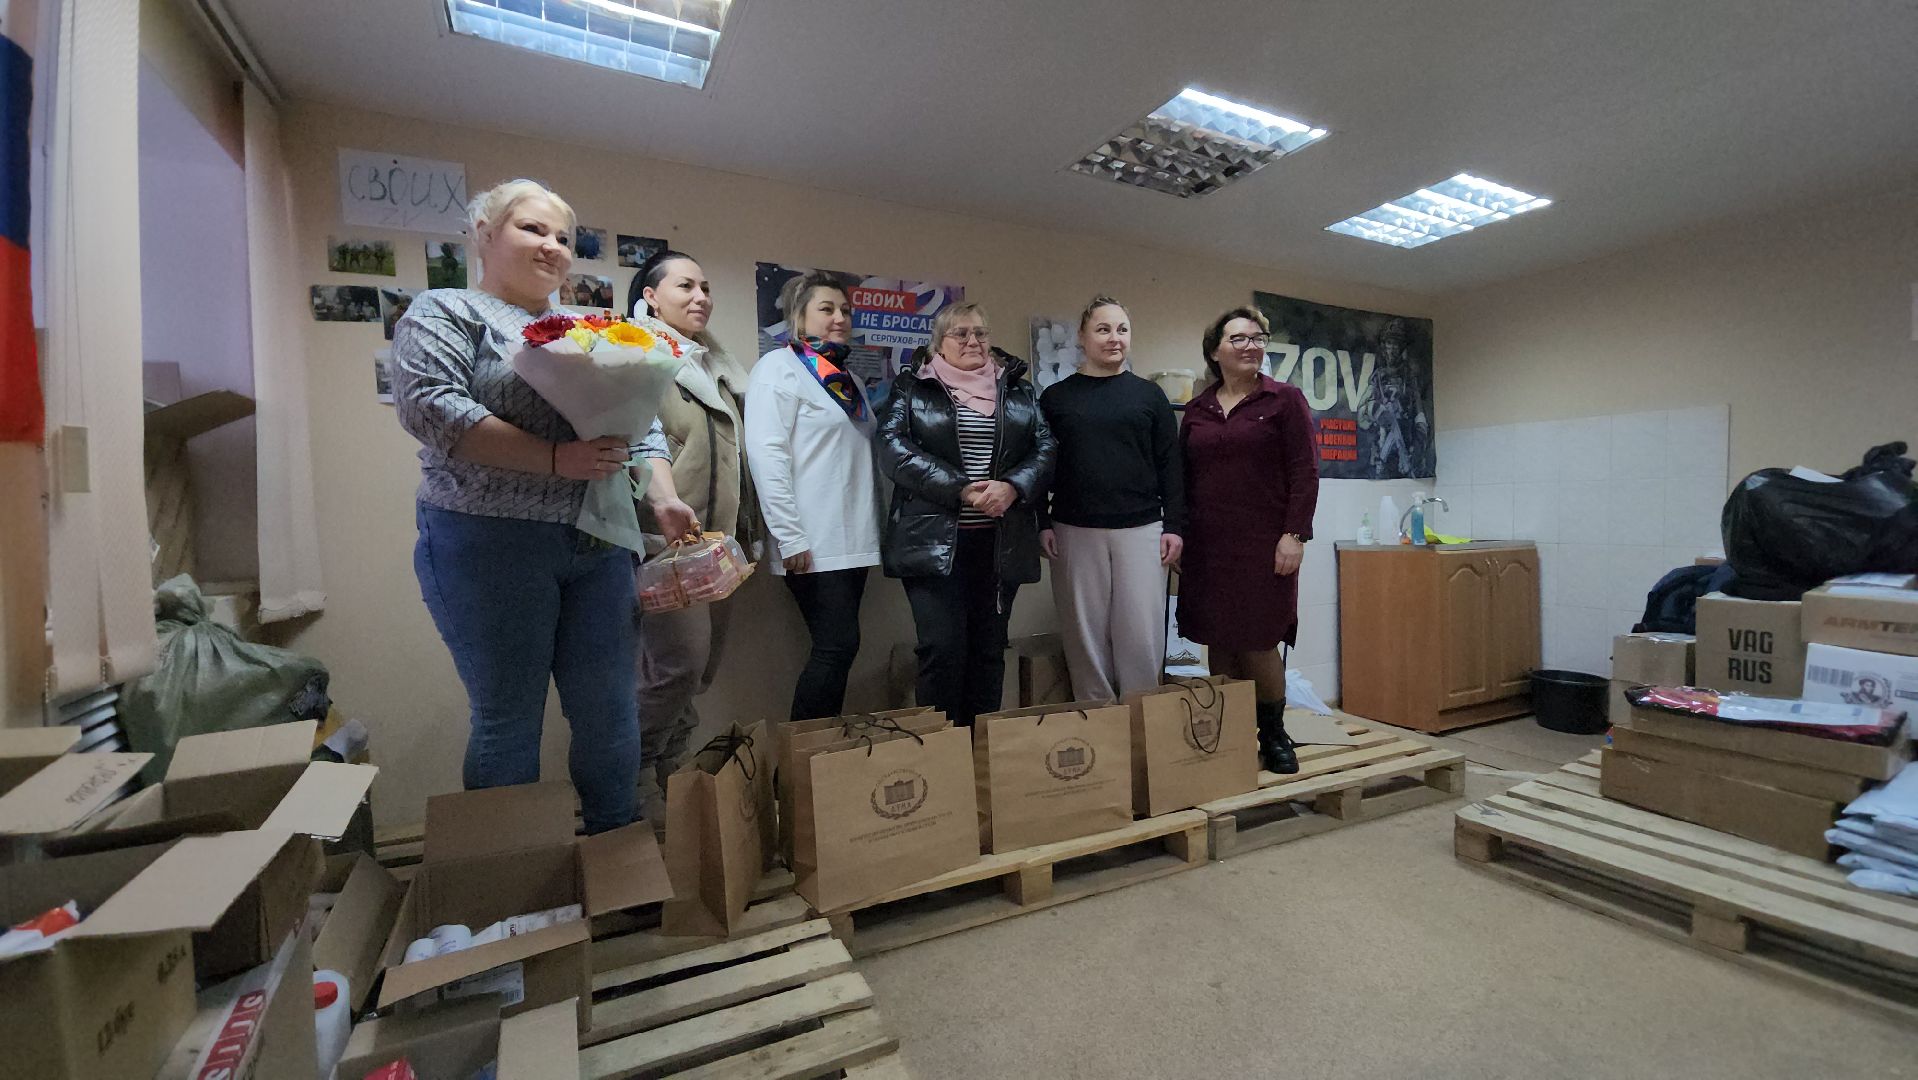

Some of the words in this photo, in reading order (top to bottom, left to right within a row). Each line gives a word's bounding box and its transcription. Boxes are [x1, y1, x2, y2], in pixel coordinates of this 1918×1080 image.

[348, 165, 468, 214] СВОИХ
[852, 290, 905, 310] СВОИХ
[860, 312, 879, 328] НЕ
[882, 314, 936, 332] БРОСАЕ
[871, 333, 931, 346] СЕРПУХОВ-ПО
[1823, 616, 1918, 634] ARMTE
[1728, 628, 1773, 655] VAG
[1728, 656, 1773, 685] RUS
